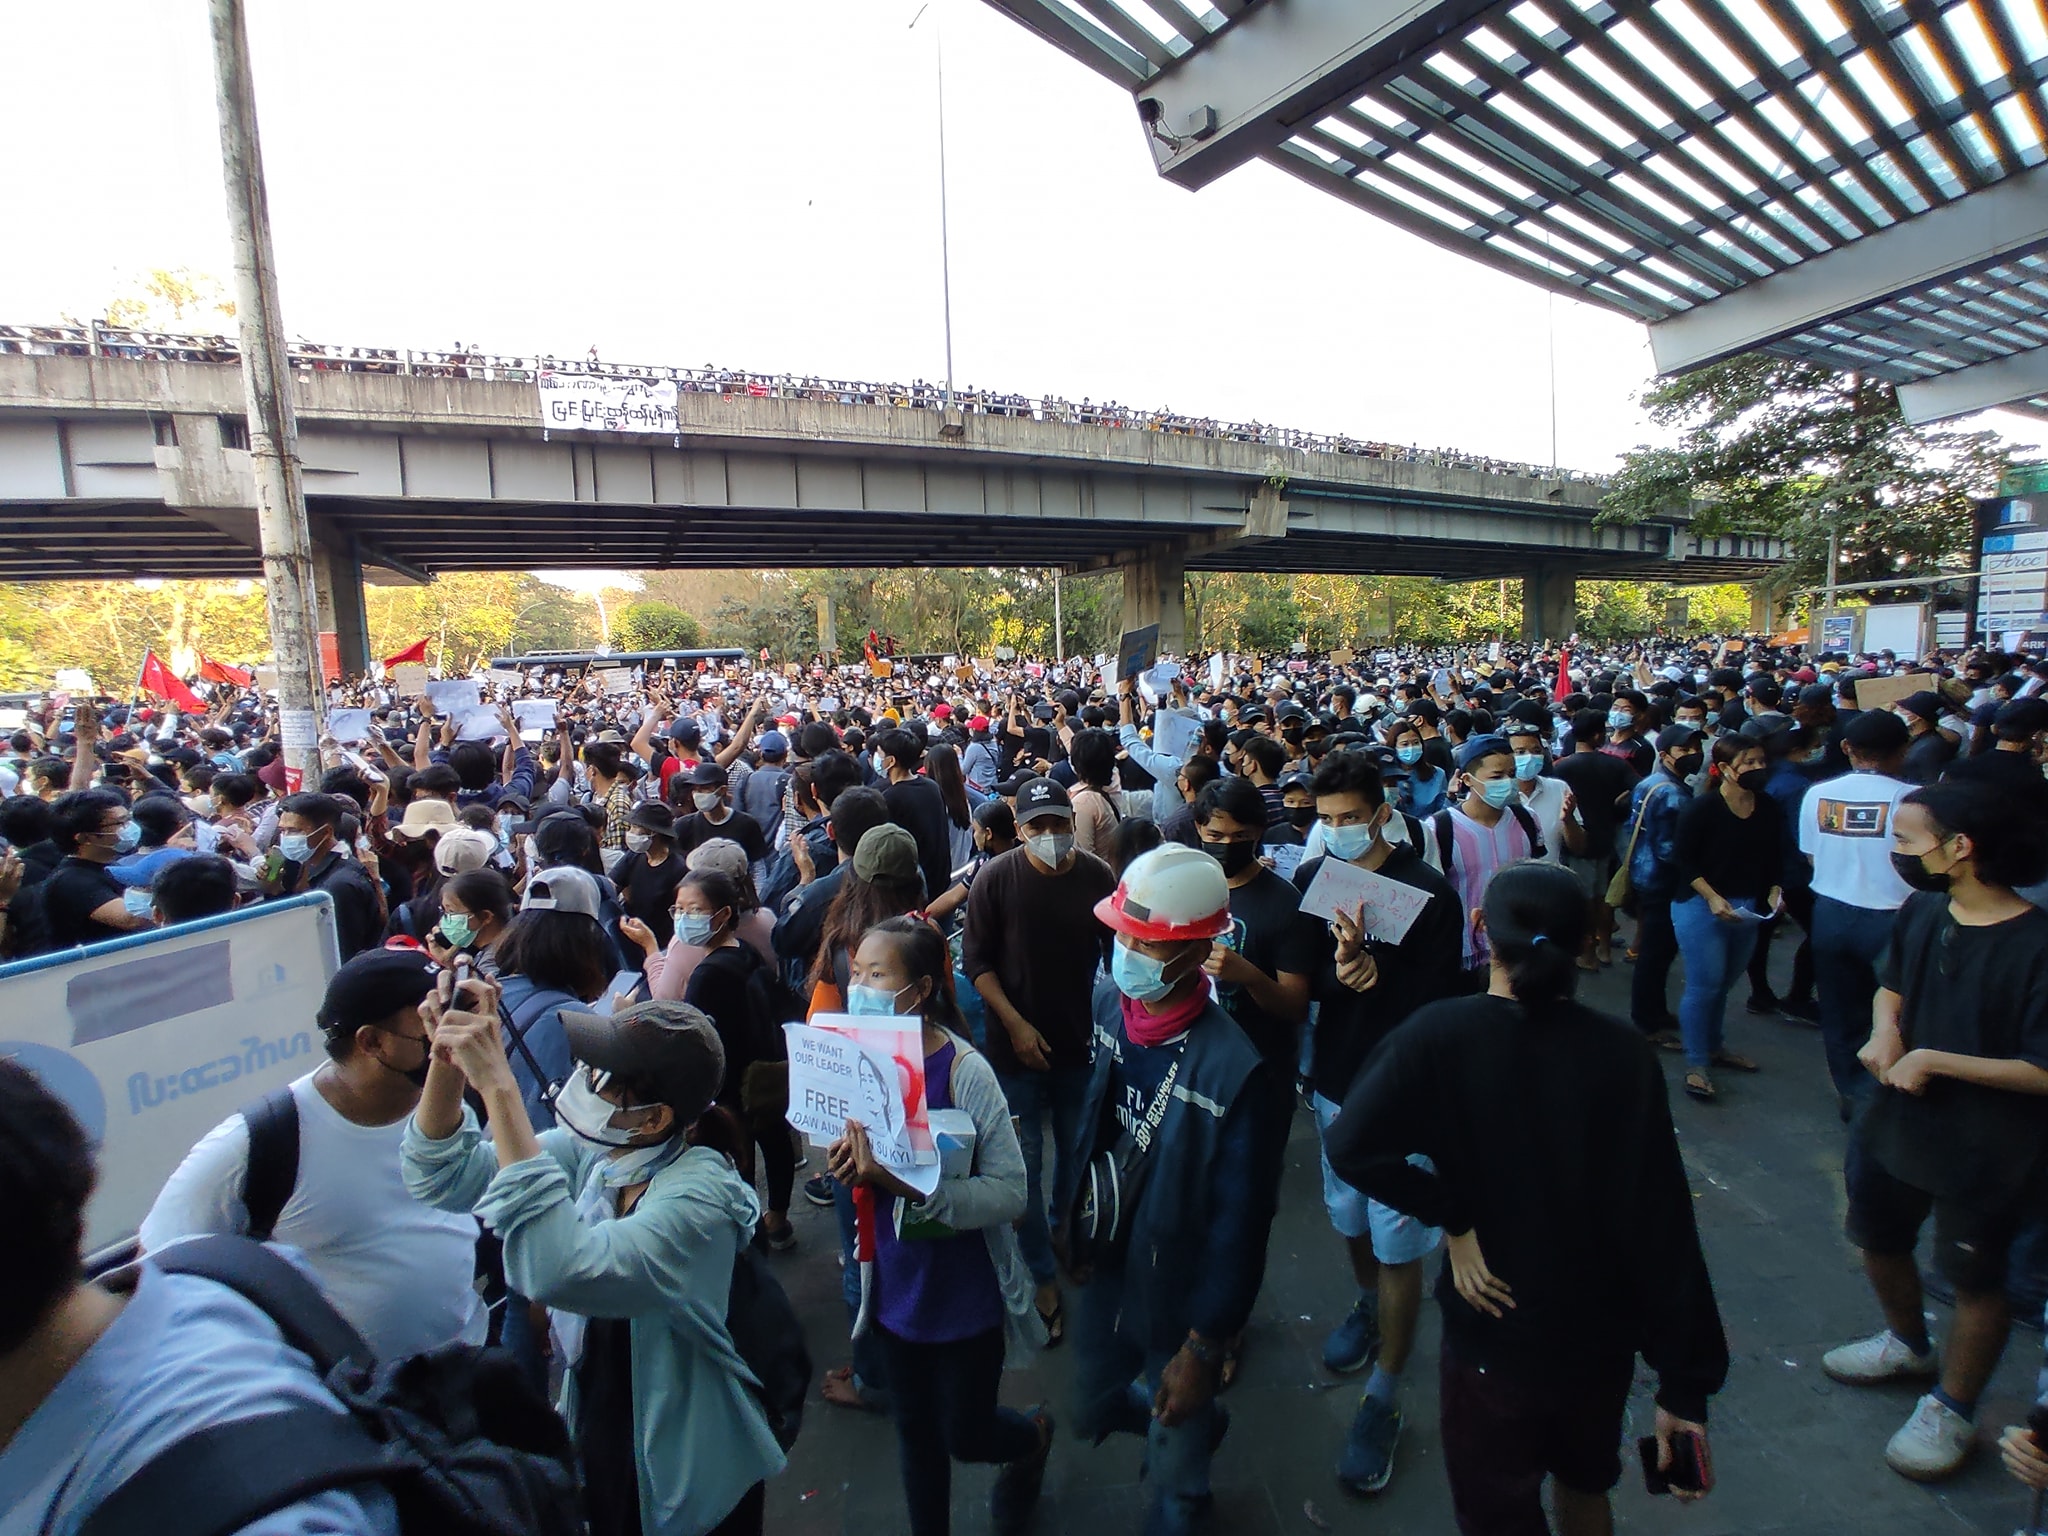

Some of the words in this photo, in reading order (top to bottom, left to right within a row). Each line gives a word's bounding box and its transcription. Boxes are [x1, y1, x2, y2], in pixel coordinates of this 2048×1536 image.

[802, 1037, 816, 1051] WE
[817, 1042, 843, 1059] WANT
[795, 1051, 814, 1066] OUR
[816, 1057, 852, 1078] LEADER
[805, 1088, 849, 1120] FREE
[792, 1111, 818, 1130] DAW
[876, 1140, 888, 1158] SU
[890, 1149, 911, 1163] KYI
